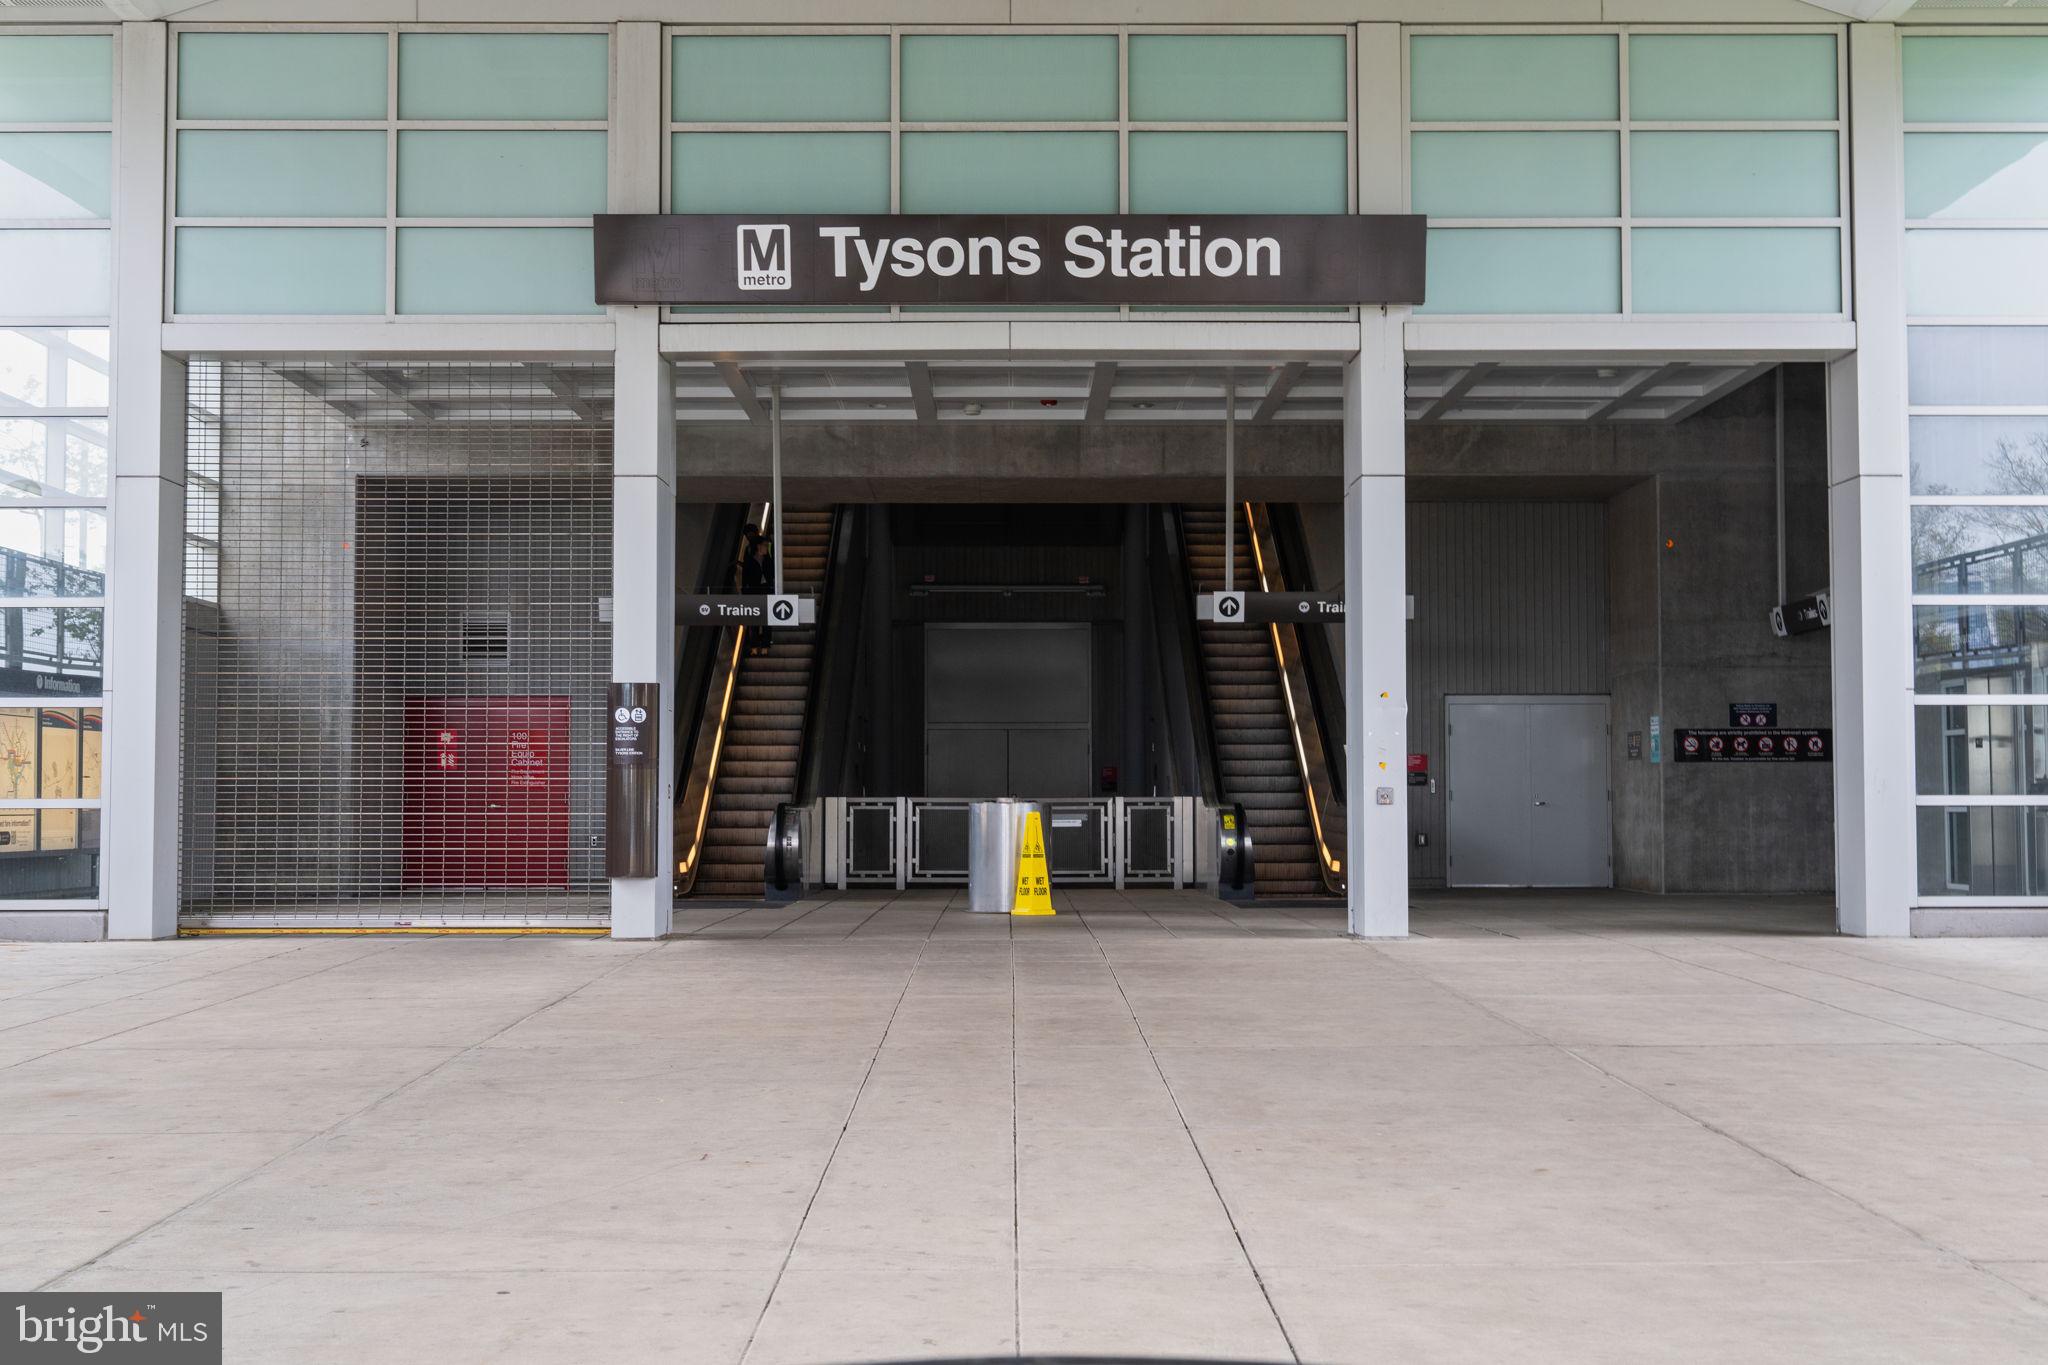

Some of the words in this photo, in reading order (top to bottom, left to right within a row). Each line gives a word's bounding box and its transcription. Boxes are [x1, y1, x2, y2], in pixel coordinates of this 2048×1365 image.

[819, 226, 1041, 291] Tysons
[1064, 225, 1281, 278] Station
[743, 273, 786, 286] metro
[717, 604, 761, 616] Trains
[1317, 601, 1345, 613] Trai
[44, 676, 81, 693] Information
[512, 741, 527, 749] Fire
[511, 758, 543, 767] Cabinet
[1035, 877, 1044, 885] WET
[1034, 887, 1048, 895] FLOOR
